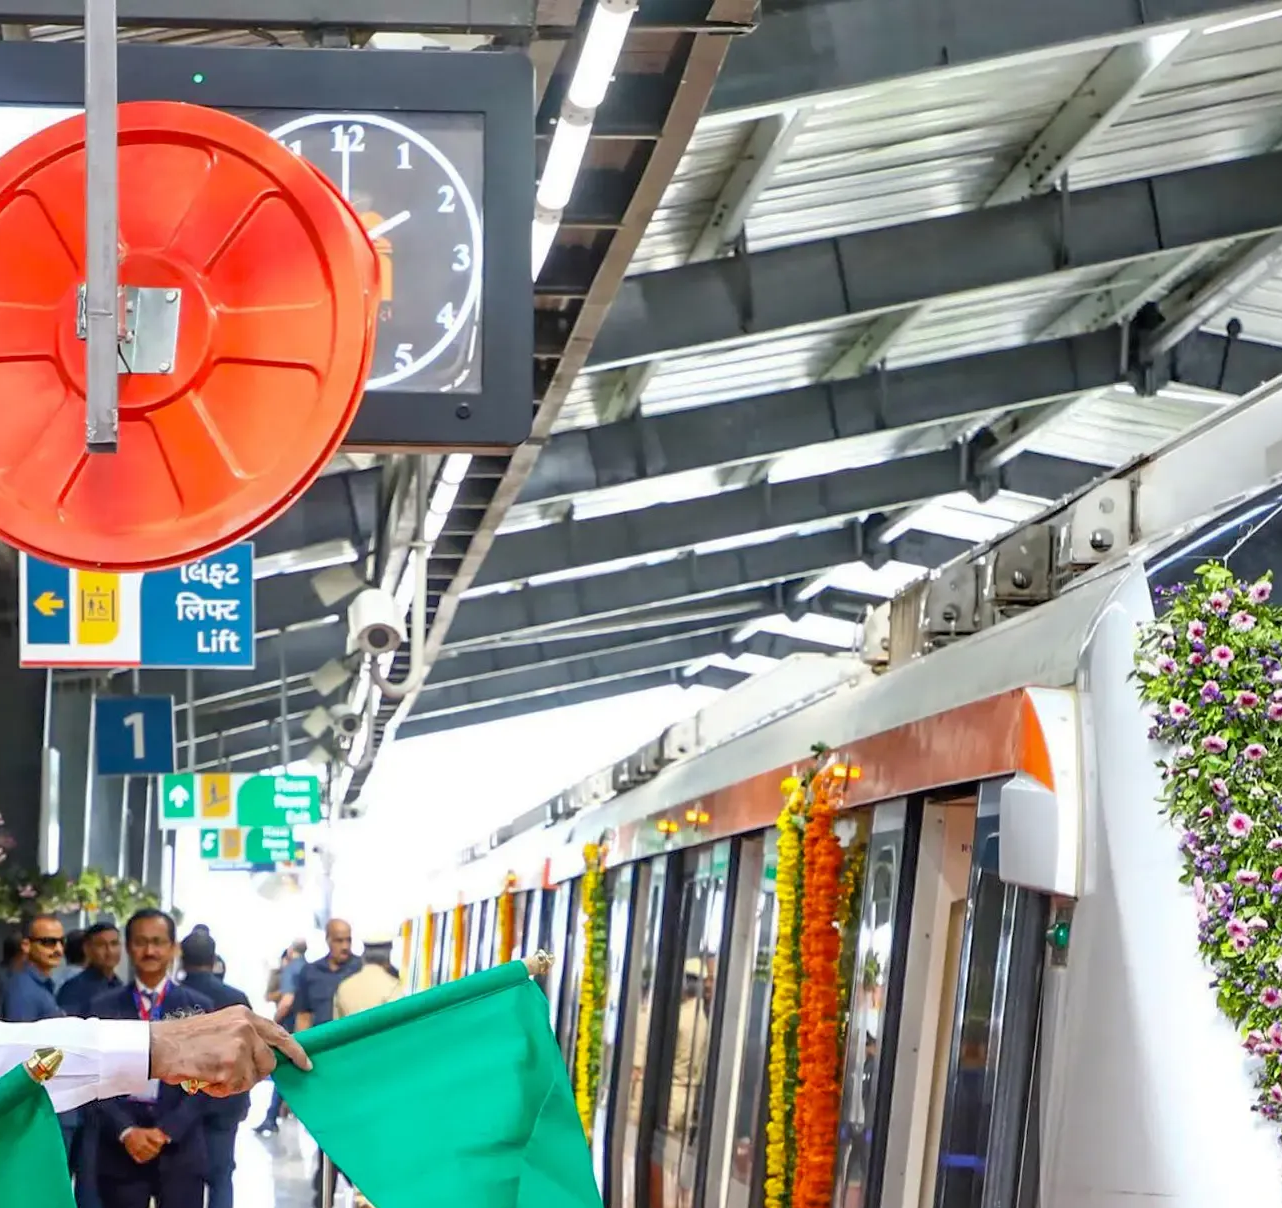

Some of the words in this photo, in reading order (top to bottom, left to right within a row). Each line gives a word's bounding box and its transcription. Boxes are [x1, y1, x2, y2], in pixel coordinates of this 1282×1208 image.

[330, 124, 365, 152] 12
[396, 143, 412, 169] 1
[437, 185, 455, 212] 2
[451, 244, 471, 271] 3
[436, 302, 455, 330] 4
[394, 343, 413, 371] 5
[175, 591, 240, 621] लिफ्ट
[197, 628, 241, 653] Lift
[123, 711, 146, 760] 1
